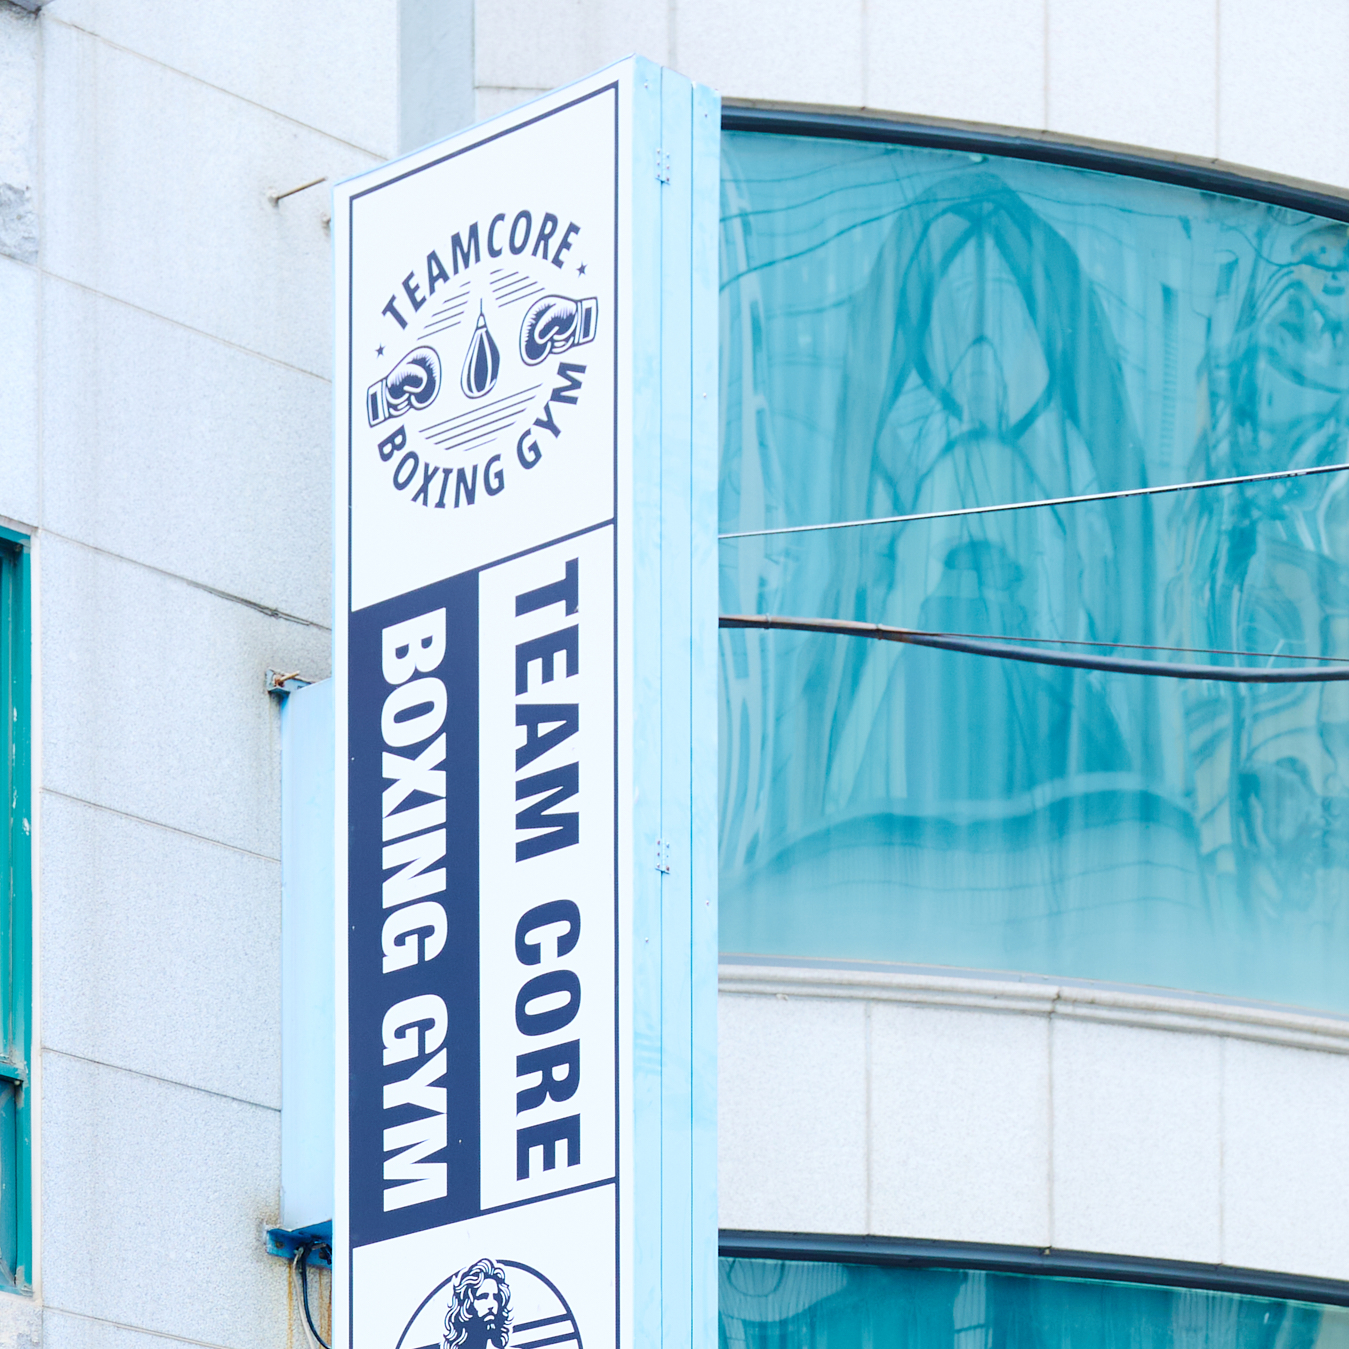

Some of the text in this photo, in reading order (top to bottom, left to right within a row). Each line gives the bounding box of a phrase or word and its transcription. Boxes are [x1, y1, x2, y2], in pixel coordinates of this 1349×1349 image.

[377, 361, 587, 509] BOXING GYM
[380, 209, 581, 330] TEAMCORE
[381, 607, 448, 1213] BOXING GYM
[515, 557, 581, 1182] TEAM CORE
